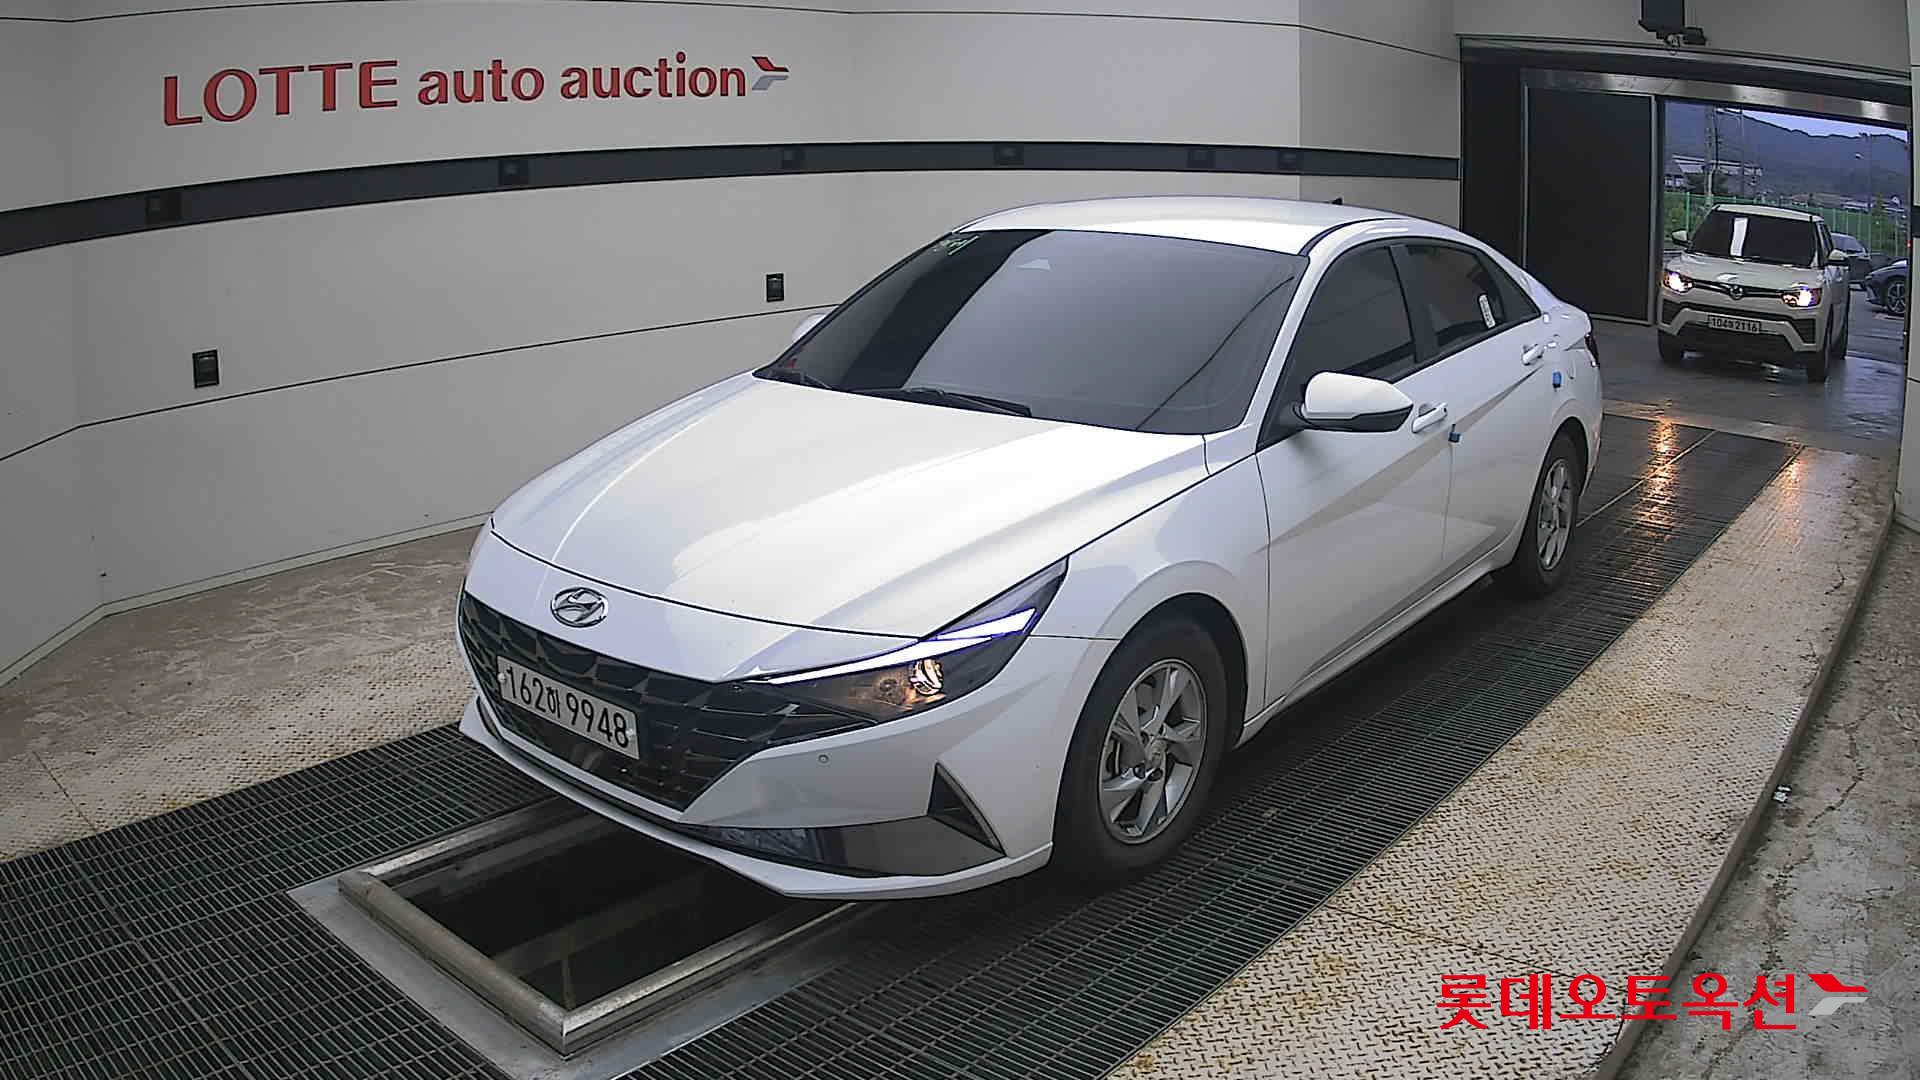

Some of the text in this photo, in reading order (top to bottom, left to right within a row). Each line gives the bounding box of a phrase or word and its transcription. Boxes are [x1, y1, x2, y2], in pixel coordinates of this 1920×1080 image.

[163, 52, 748, 126] LOTTE auto auction
[506, 666, 629, 748] 162하 9948
